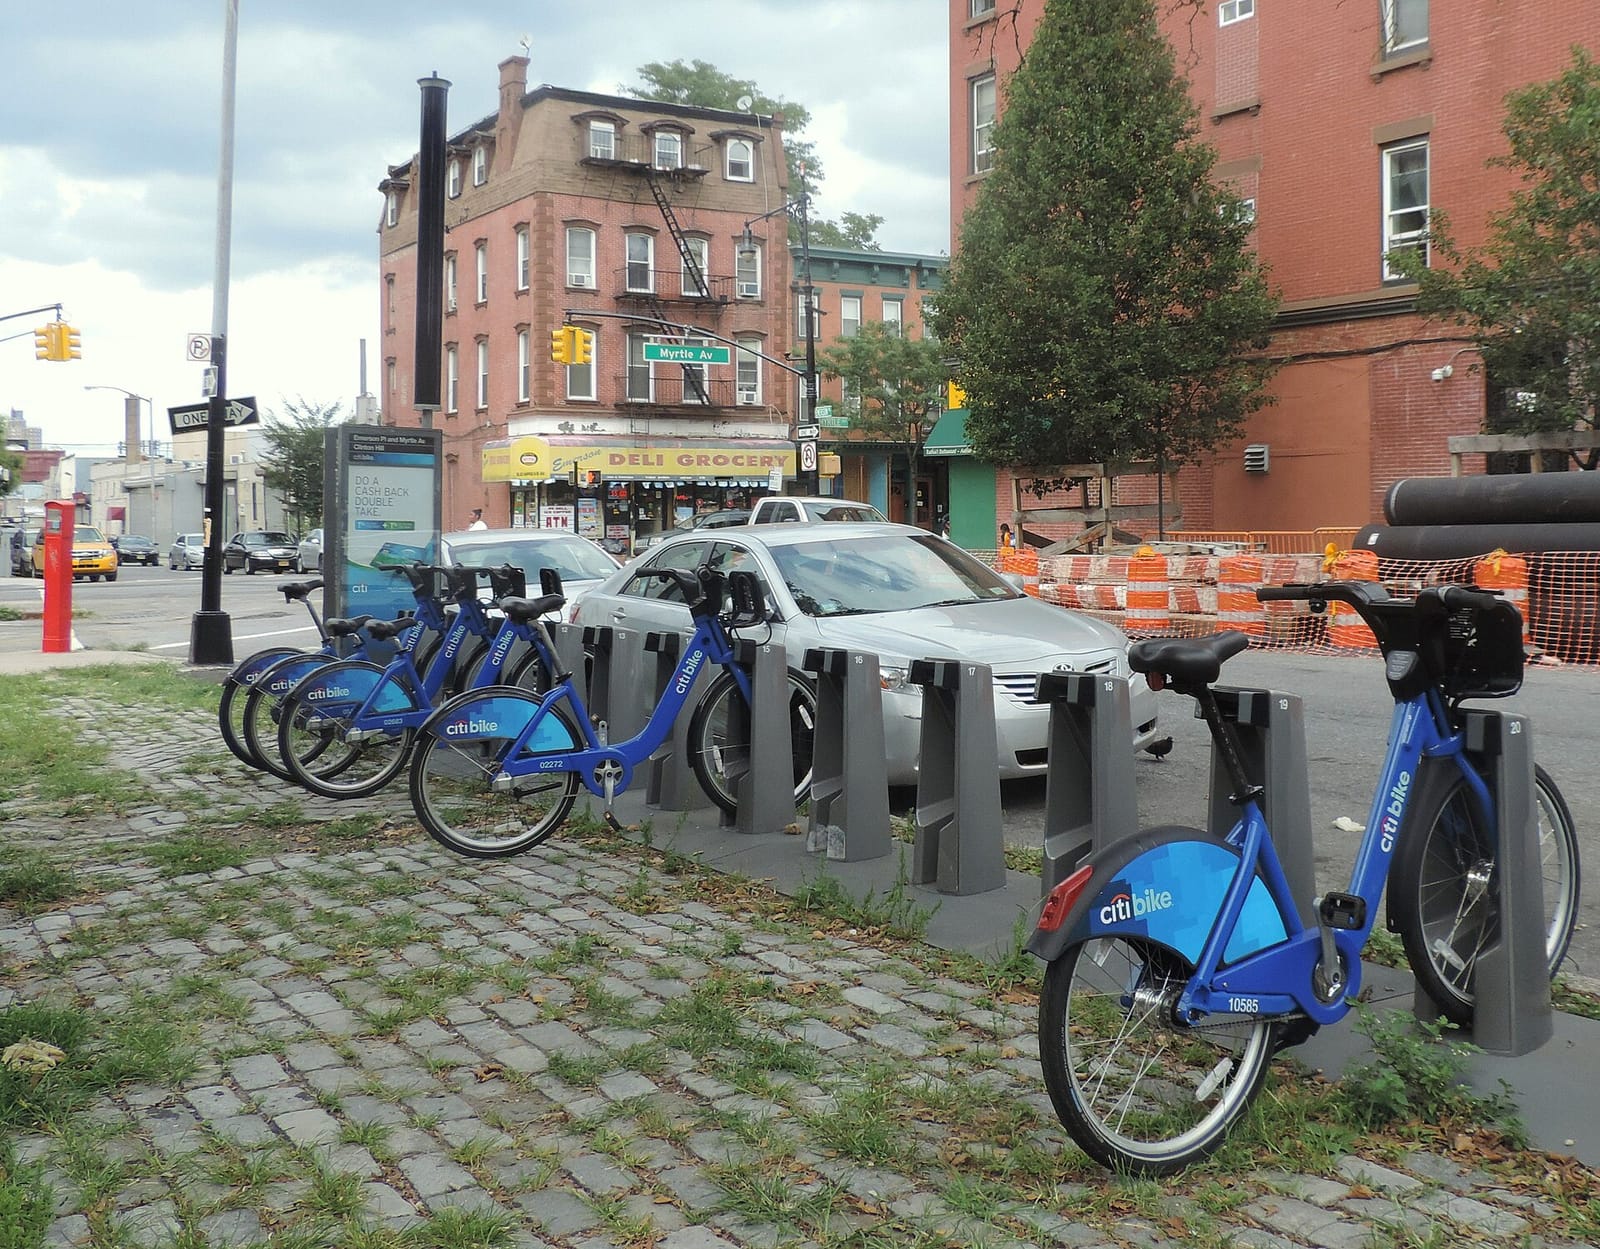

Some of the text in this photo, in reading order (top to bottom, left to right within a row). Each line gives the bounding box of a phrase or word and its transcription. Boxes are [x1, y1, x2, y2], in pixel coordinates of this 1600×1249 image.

[660, 348, 713, 360] Myrtle Av
[182, 405, 244, 425] ONE AY
[552, 449, 601, 472] Emerson
[608, 453, 664, 466] DELI
[676, 454, 790, 468] GROCERY
[355, 476, 379, 485] DO A
[355, 486, 409, 497] CASH BACK
[355, 497, 393, 507] DOUBLE
[352, 584, 368, 593] citi
[618, 632, 626, 640] 13
[762, 645, 771, 653] 15
[854, 655, 863, 664] 16
[968, 666, 976, 676] 17
[1104, 681, 1113, 691] 18
[1279, 699, 1289, 710] 19
[1510, 721, 1521, 735] 20
[540, 760, 563, 769] 02272
[1228, 997, 1259, 1013] 10585
